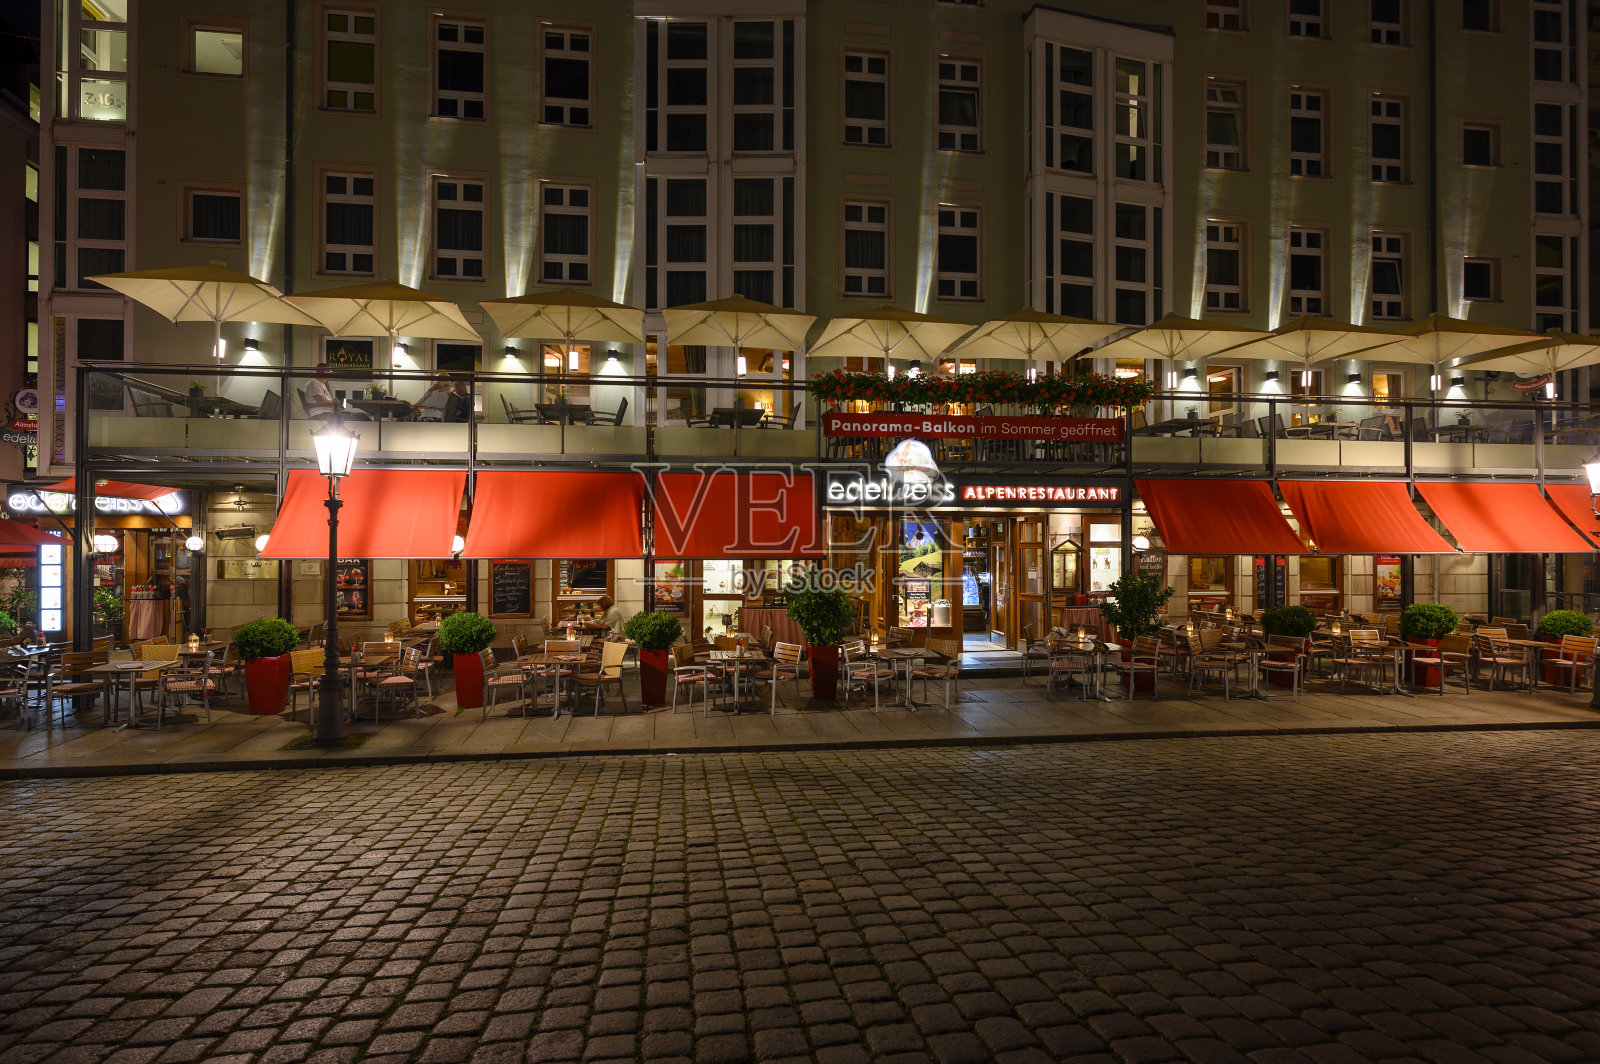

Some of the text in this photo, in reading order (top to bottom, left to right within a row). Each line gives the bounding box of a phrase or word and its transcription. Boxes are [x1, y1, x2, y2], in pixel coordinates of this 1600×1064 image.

[329, 351, 369, 362] ROYAL
[831, 420, 1117, 438] Panorama-Balkon im Sommer geöffnet
[828, 477, 956, 501] edelweiss
[965, 487, 1118, 500] ALPENRESTAURANT
